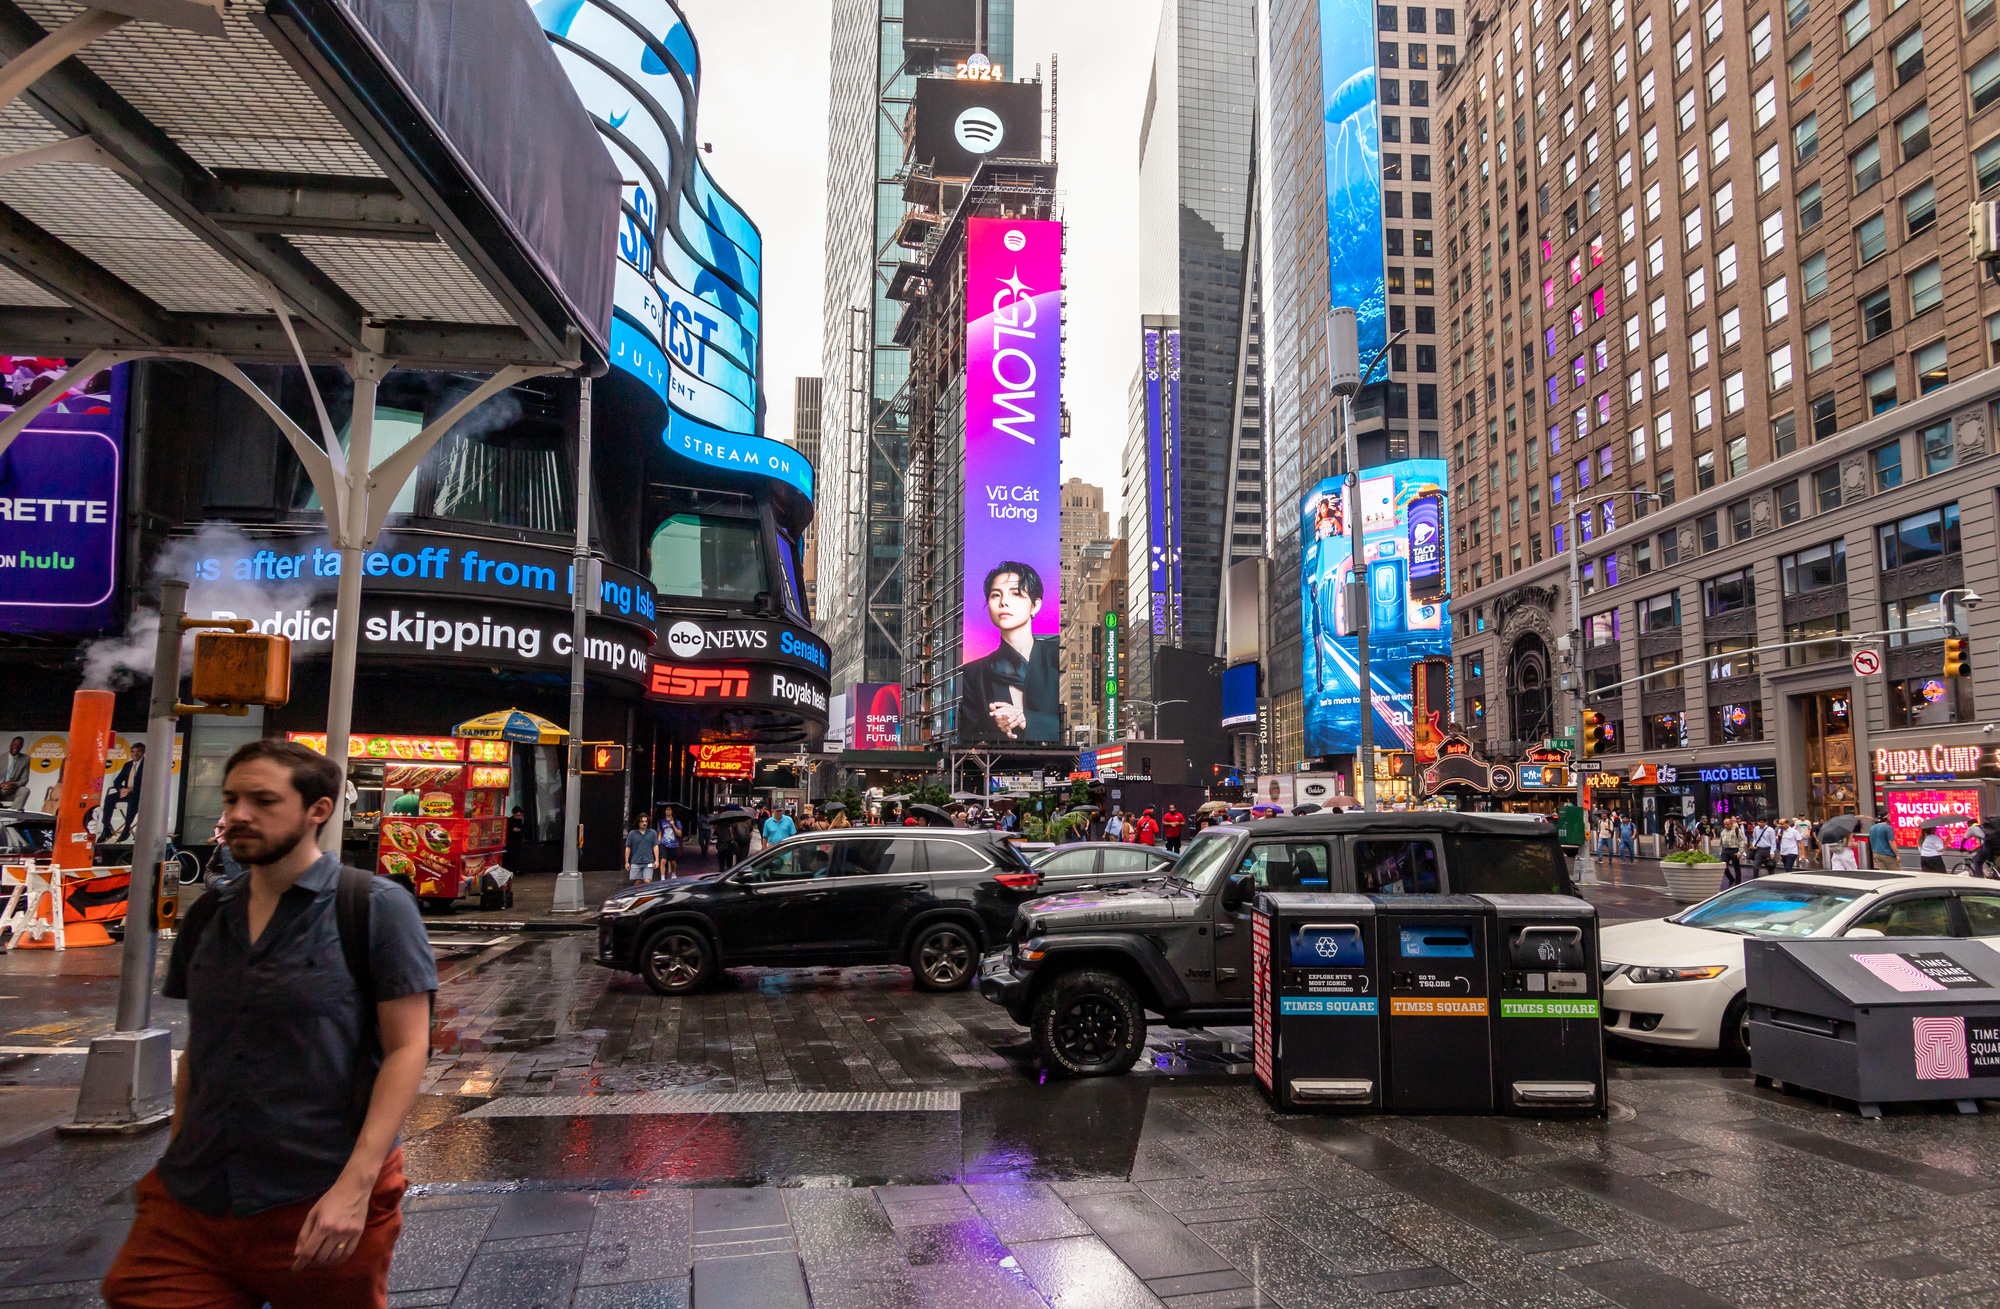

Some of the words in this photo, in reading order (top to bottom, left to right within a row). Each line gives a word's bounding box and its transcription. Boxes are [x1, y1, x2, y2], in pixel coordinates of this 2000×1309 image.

[957, 63, 1002, 80] 2024
[1146, 333, 1159, 368] ROKU
[617, 342, 663, 385] JULY
[992, 284, 1037, 446] GLOW
[684, 435, 759, 464] STREAM
[769, 456, 790, 474] ON
[986, 485, 1008, 501] Vũ
[1011, 485, 1040, 502] Cát
[0, 497, 107, 523] RETTE
[987, 502, 1038, 523] Tường
[1413, 544, 1436, 555] TACO
[20, 550, 75, 570] hulu
[1414, 553, 1437, 564] BELL
[232, 550, 306, 580] after
[312, 547, 451, 581] taeoff
[460, 551, 557, 592] from
[1153, 595, 1167, 635] ROKU
[364, 610, 541, 659] skipping
[670, 632, 702, 645] abc
[704, 630, 768, 649] NEWS
[780, 631, 819, 665] Senate
[1107, 630, 1115, 662] Delicious
[1107, 662, 1115, 678] Live
[651, 664, 750, 698] ESPN
[772, 674, 811, 705] Royals
[1333, 697, 1351, 705] more
[1352, 696, 1360, 704] to
[866, 715, 898, 723] SHAPE
[1107, 697, 1115, 730] Delicious
[460, 728, 502, 737] SABRETT
[866, 724, 886, 733] THE
[1259, 704, 1268, 744] SQUARE
[1447, 744, 1458, 754] Hard
[1458, 743, 1468, 754] Rock
[700, 761, 720, 769] BAKE
[721, 762, 742, 770] SHOP
[1547, 753, 1562, 762] Rock
[1876, 748, 1931, 775] BUBBA
[1931, 744, 1982, 773] GUMP
[1600, 772, 1621, 789] Shop
[1699, 767, 1730, 782] TACO
[1730, 766, 1761, 781] BELL
[1895, 802, 1950, 815] MUSEUM
[1953, 802, 1972, 814] OF
[1914, 959, 1953, 968] TIMES
[1922, 967, 1969, 977] SQUARE
[1185, 966, 1211, 979] Jeep
[1418, 980, 1451, 988] TSQ.ORG
[1283, 1001, 1324, 1012] TIMES
[1326, 1001, 1375, 1013] SQUARE
[1393, 1002, 1434, 1012] TIMES
[1436, 1002, 1486, 1013] SQUARE
[1503, 1004, 1544, 1014] TIMES
[1546, 1004, 1596, 1015] SQUARE
